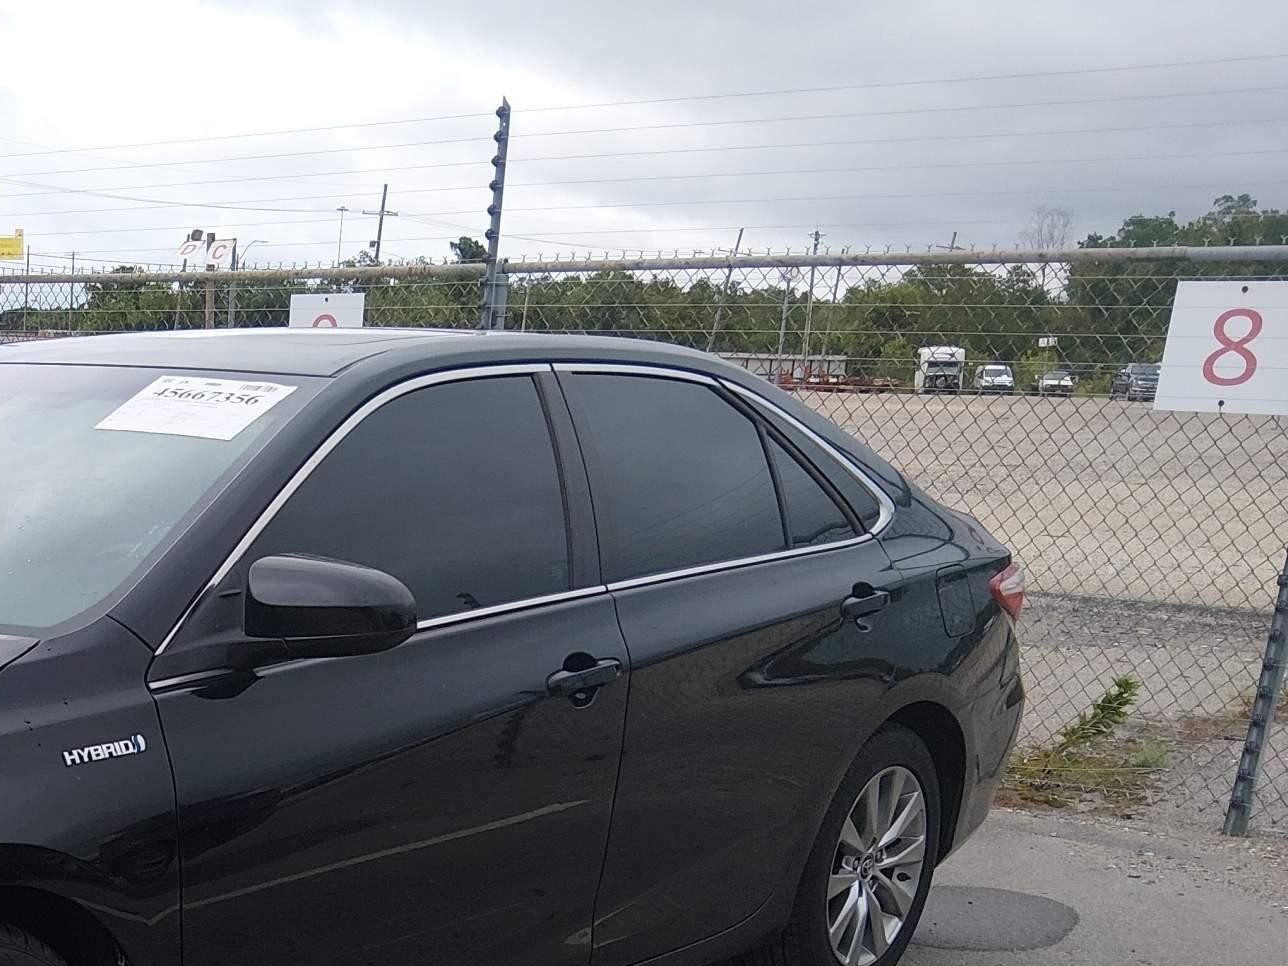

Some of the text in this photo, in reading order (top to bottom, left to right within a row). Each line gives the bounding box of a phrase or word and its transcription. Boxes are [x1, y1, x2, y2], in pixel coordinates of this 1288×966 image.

[211, 244, 228, 260] C
[1202, 307, 1264, 387] 8
[153, 386, 265, 406] 45667356
[62, 739, 134, 766] HYBRID
